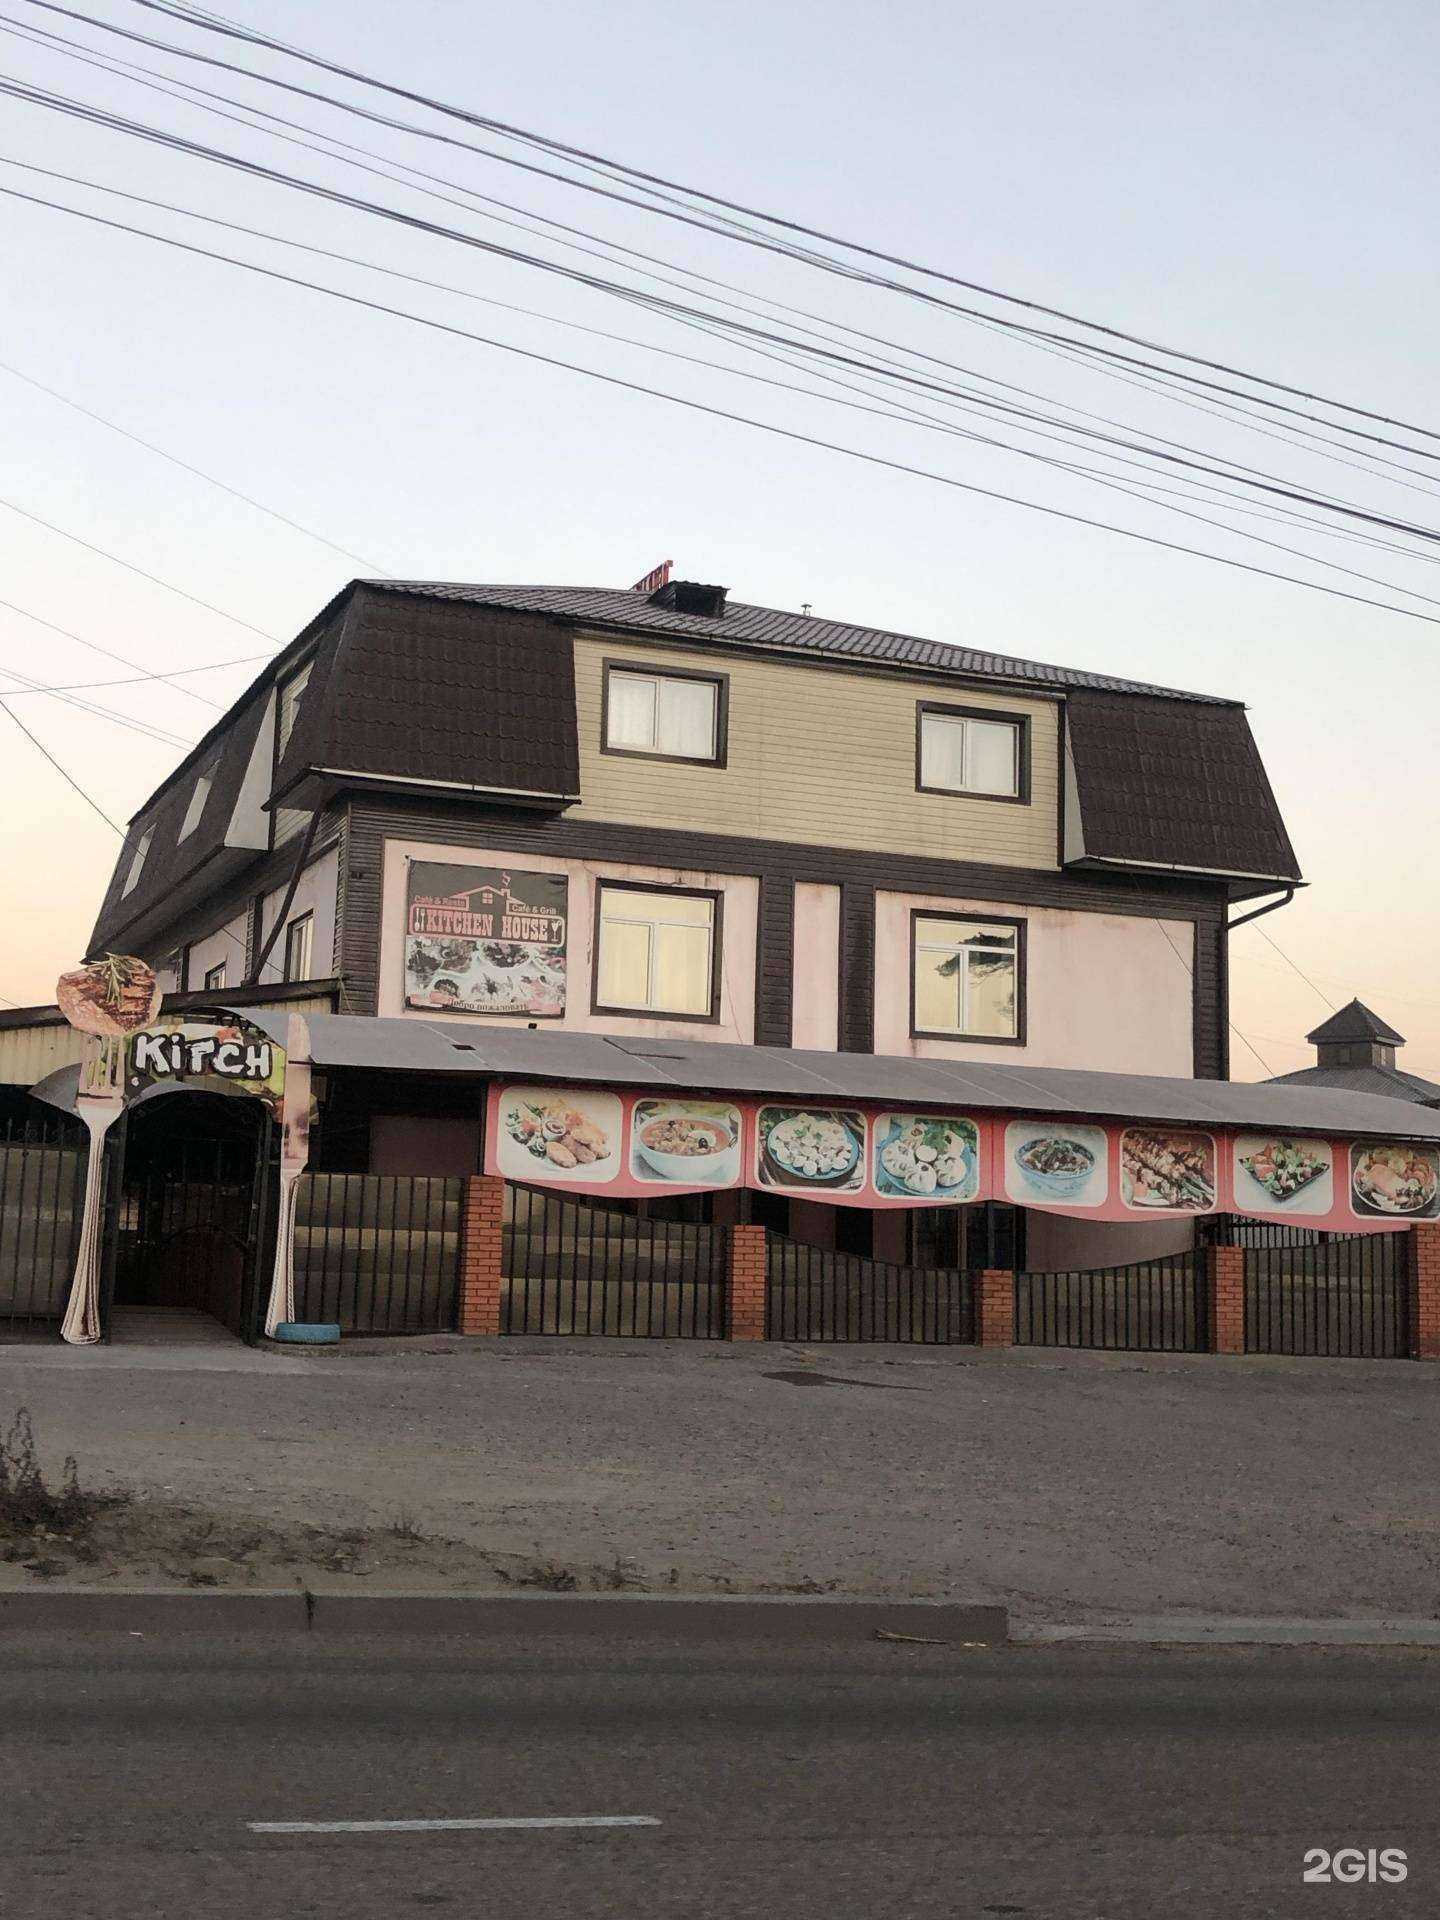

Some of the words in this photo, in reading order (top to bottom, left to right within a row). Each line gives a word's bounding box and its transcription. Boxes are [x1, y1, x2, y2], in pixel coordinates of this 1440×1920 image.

[540, 906, 557, 915] Grill
[426, 909, 494, 937] KITCHEN
[502, 915, 548, 941] HOUSE
